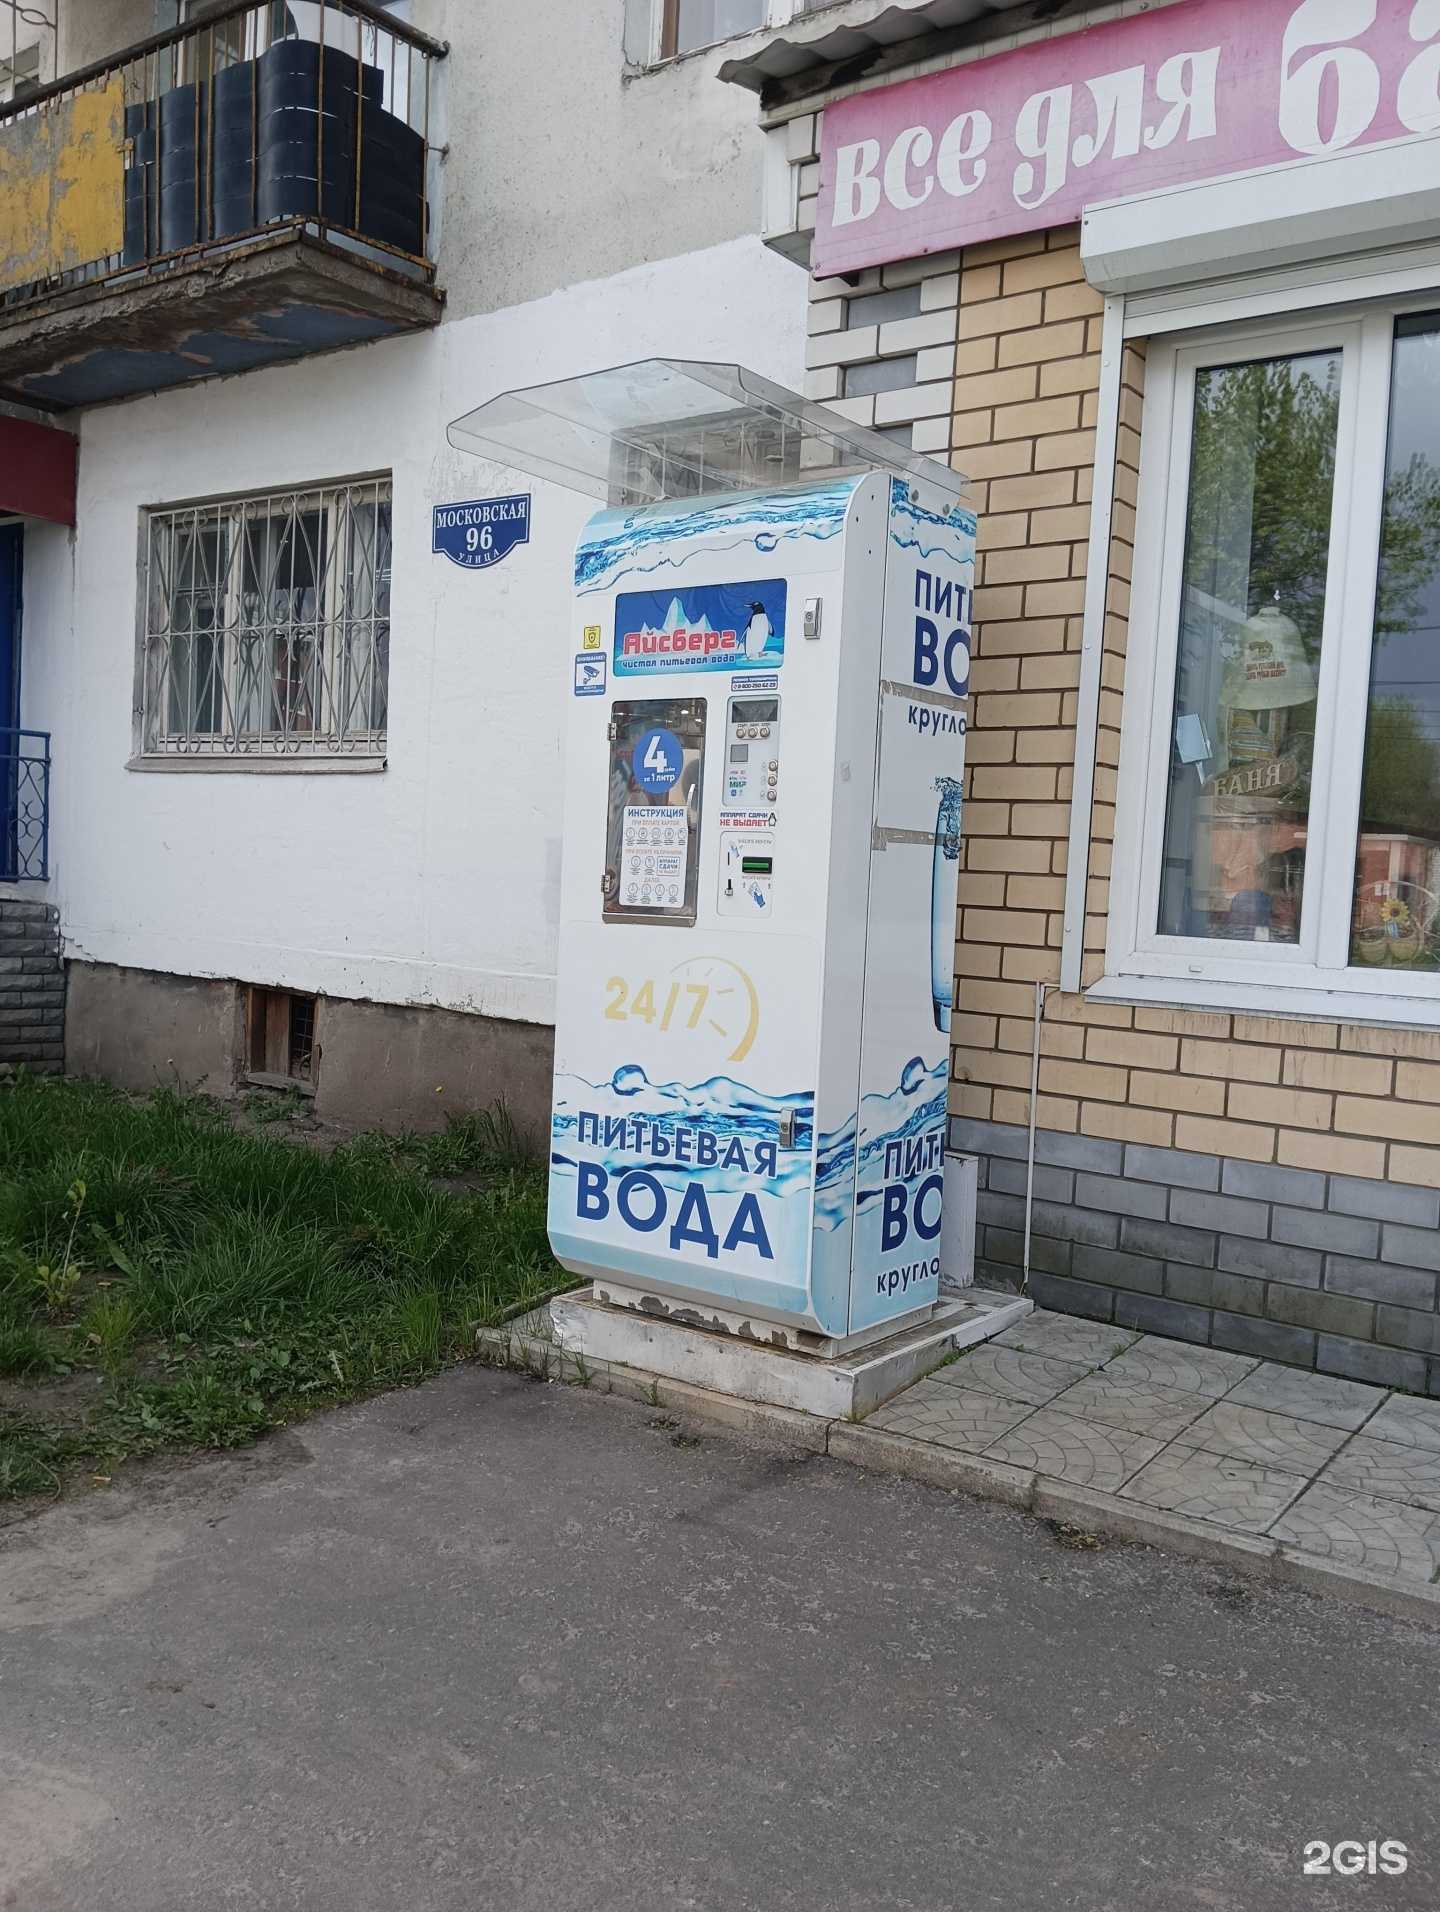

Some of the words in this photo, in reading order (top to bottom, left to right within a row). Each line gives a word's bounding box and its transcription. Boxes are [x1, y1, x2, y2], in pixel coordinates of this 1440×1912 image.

[832, 108, 993, 228] все
[1012, 45, 1222, 210] для
[436, 501, 526, 529] МОСКОВСКАЯ
[465, 525, 493, 552] 96
[457, 548, 500, 564] УЛИЦА
[623, 629, 736, 655] Айсберг
[622, 659, 657, 668] чистая
[660, 656, 708, 667] питьевая
[711, 654, 735, 663] вода
[908, 704, 967, 737] кругло
[643, 735, 668, 773] 4
[656, 773, 676, 783] литр
[1213, 762, 1283, 798] БАНЯ
[628, 808, 684, 818] ИНСТРУКЦИЯ
[733, 819, 769, 827] ВЫДАЕТ
[603, 976, 711, 1032] 24/7
[577, 1110, 778, 1178] ПИТЬЕВАЯ
[575, 1160, 775, 1260] ВОДА
[877, 1257, 940, 1297] кругло
